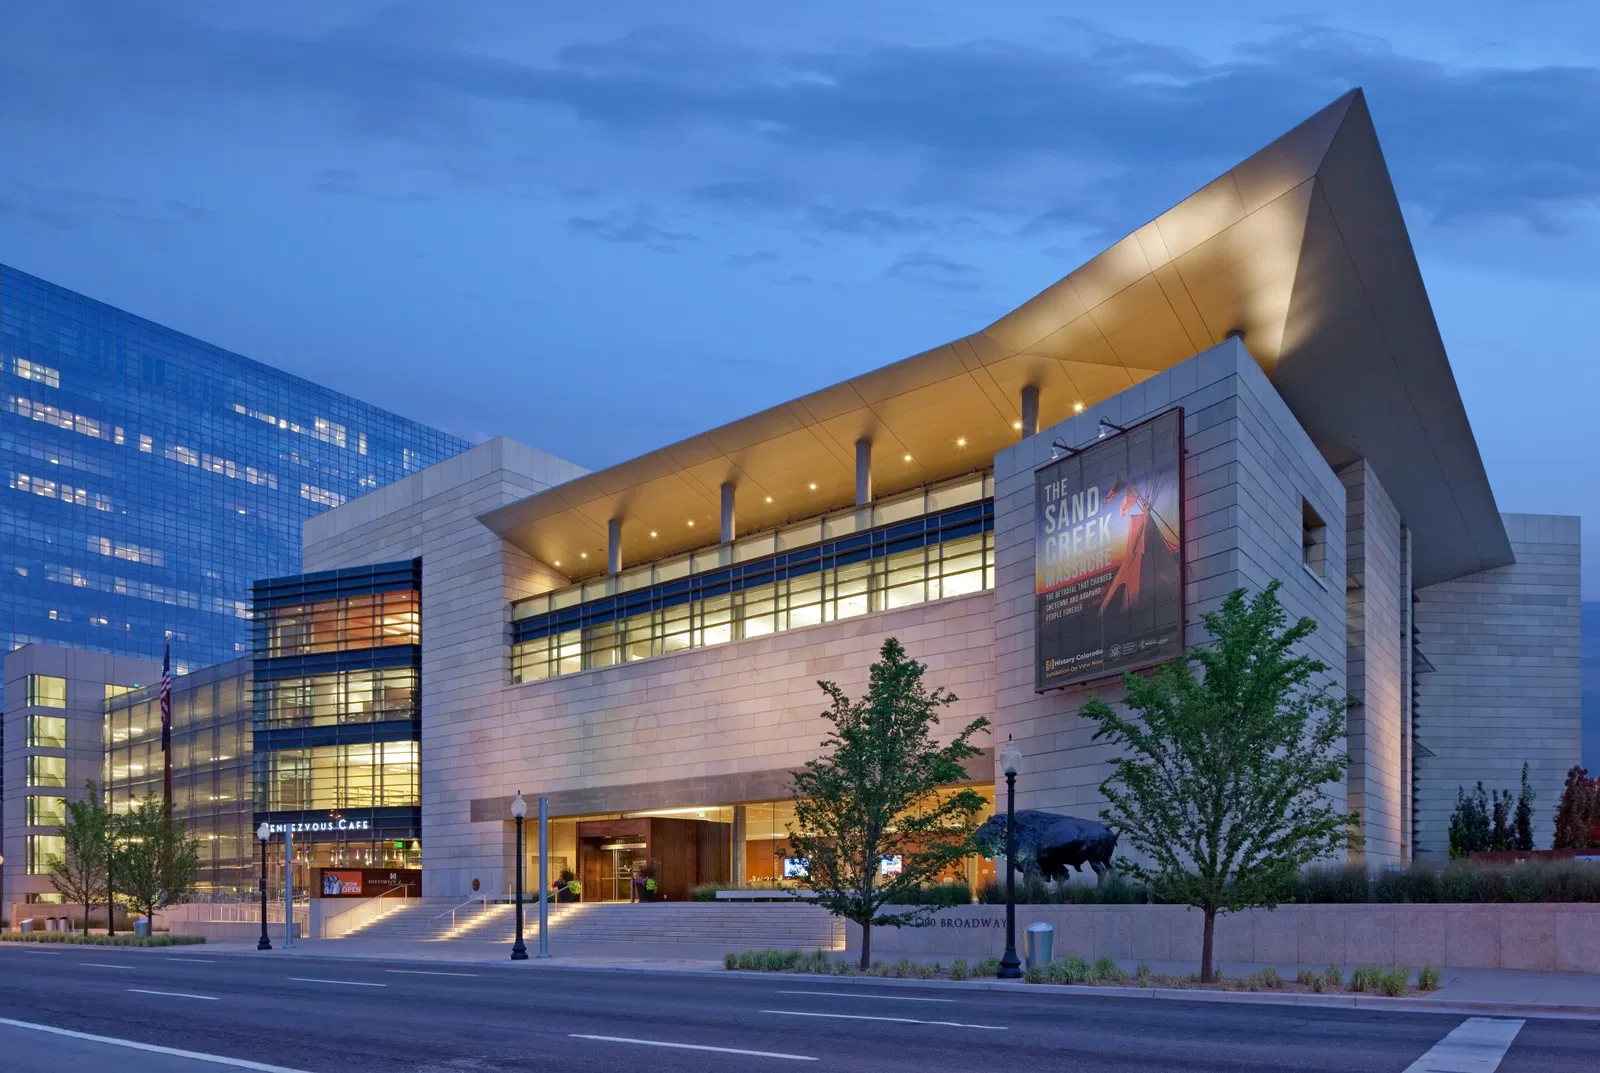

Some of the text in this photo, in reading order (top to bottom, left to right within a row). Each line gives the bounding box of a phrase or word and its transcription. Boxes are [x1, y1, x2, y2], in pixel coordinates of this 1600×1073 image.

[1045, 478, 1068, 502] THE
[1045, 486, 1099, 534] SAND
[1045, 513, 1112, 566] CREEK
[1045, 547, 1112, 588] MASSACRE
[1045, 587, 1102, 612] CHEYENNE AND ARAPAHO
[1046, 573, 1113, 602] THE BETRAYAL THAT CHANGED
[1045, 604, 1083, 622] PEOPLE FOREVER
[1055, 649, 1104, 666] History Colorado
[1045, 668, 1070, 678] Exhibition
[338, 819, 369, 830] CAFE
[940, 917, 1007, 928] BROADWAY
